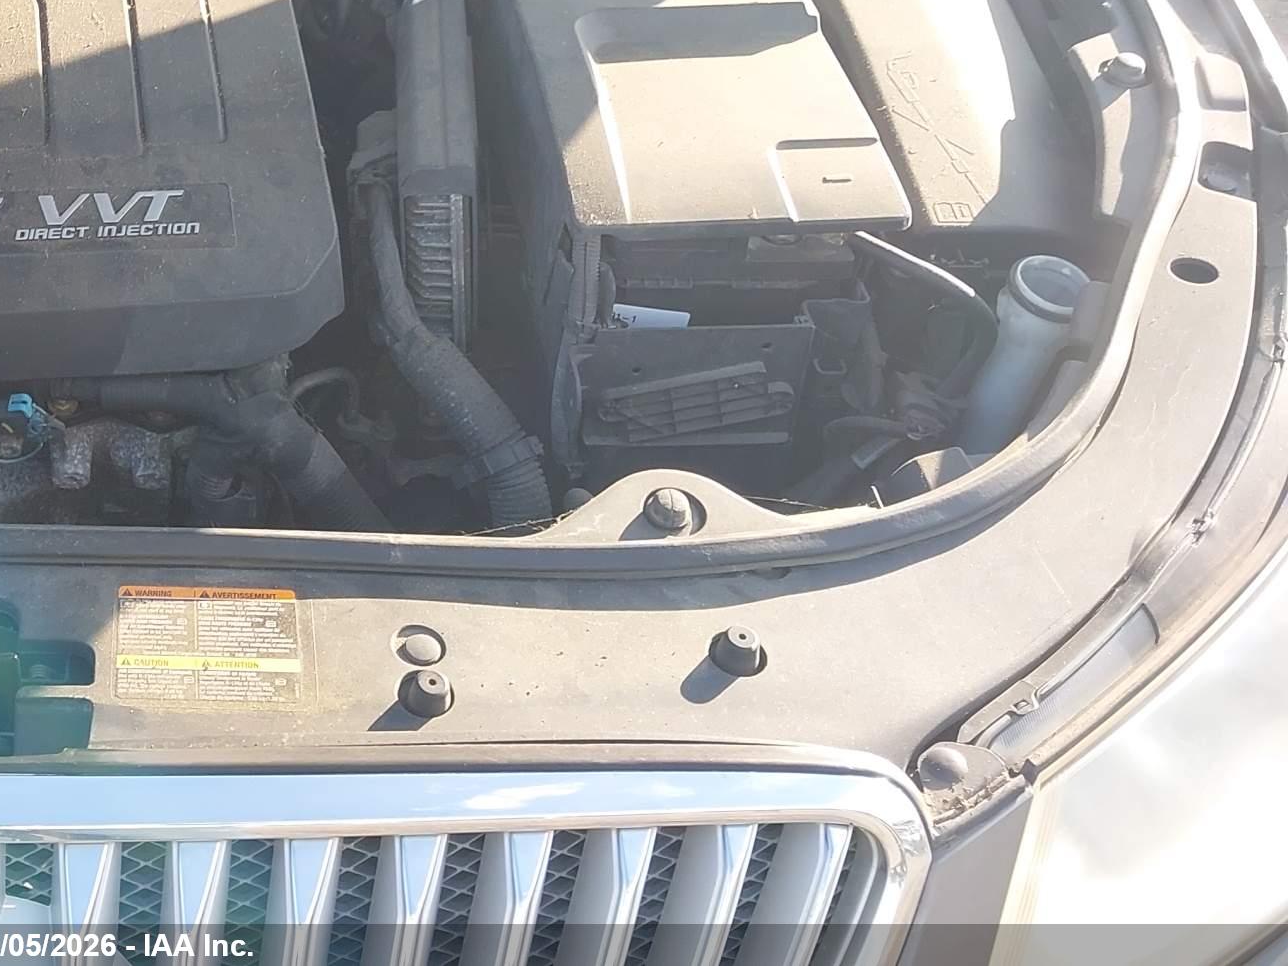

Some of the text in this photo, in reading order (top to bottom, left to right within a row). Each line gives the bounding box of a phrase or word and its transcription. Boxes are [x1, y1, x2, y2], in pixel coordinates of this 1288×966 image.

[37, 189, 185, 226] VVT
[14, 222, 201, 242] DIRECT INJECTION
[212, 592, 277, 600] AVERTISSEMENT
[133, 658, 259, 669] CAUTION ATTENTION
